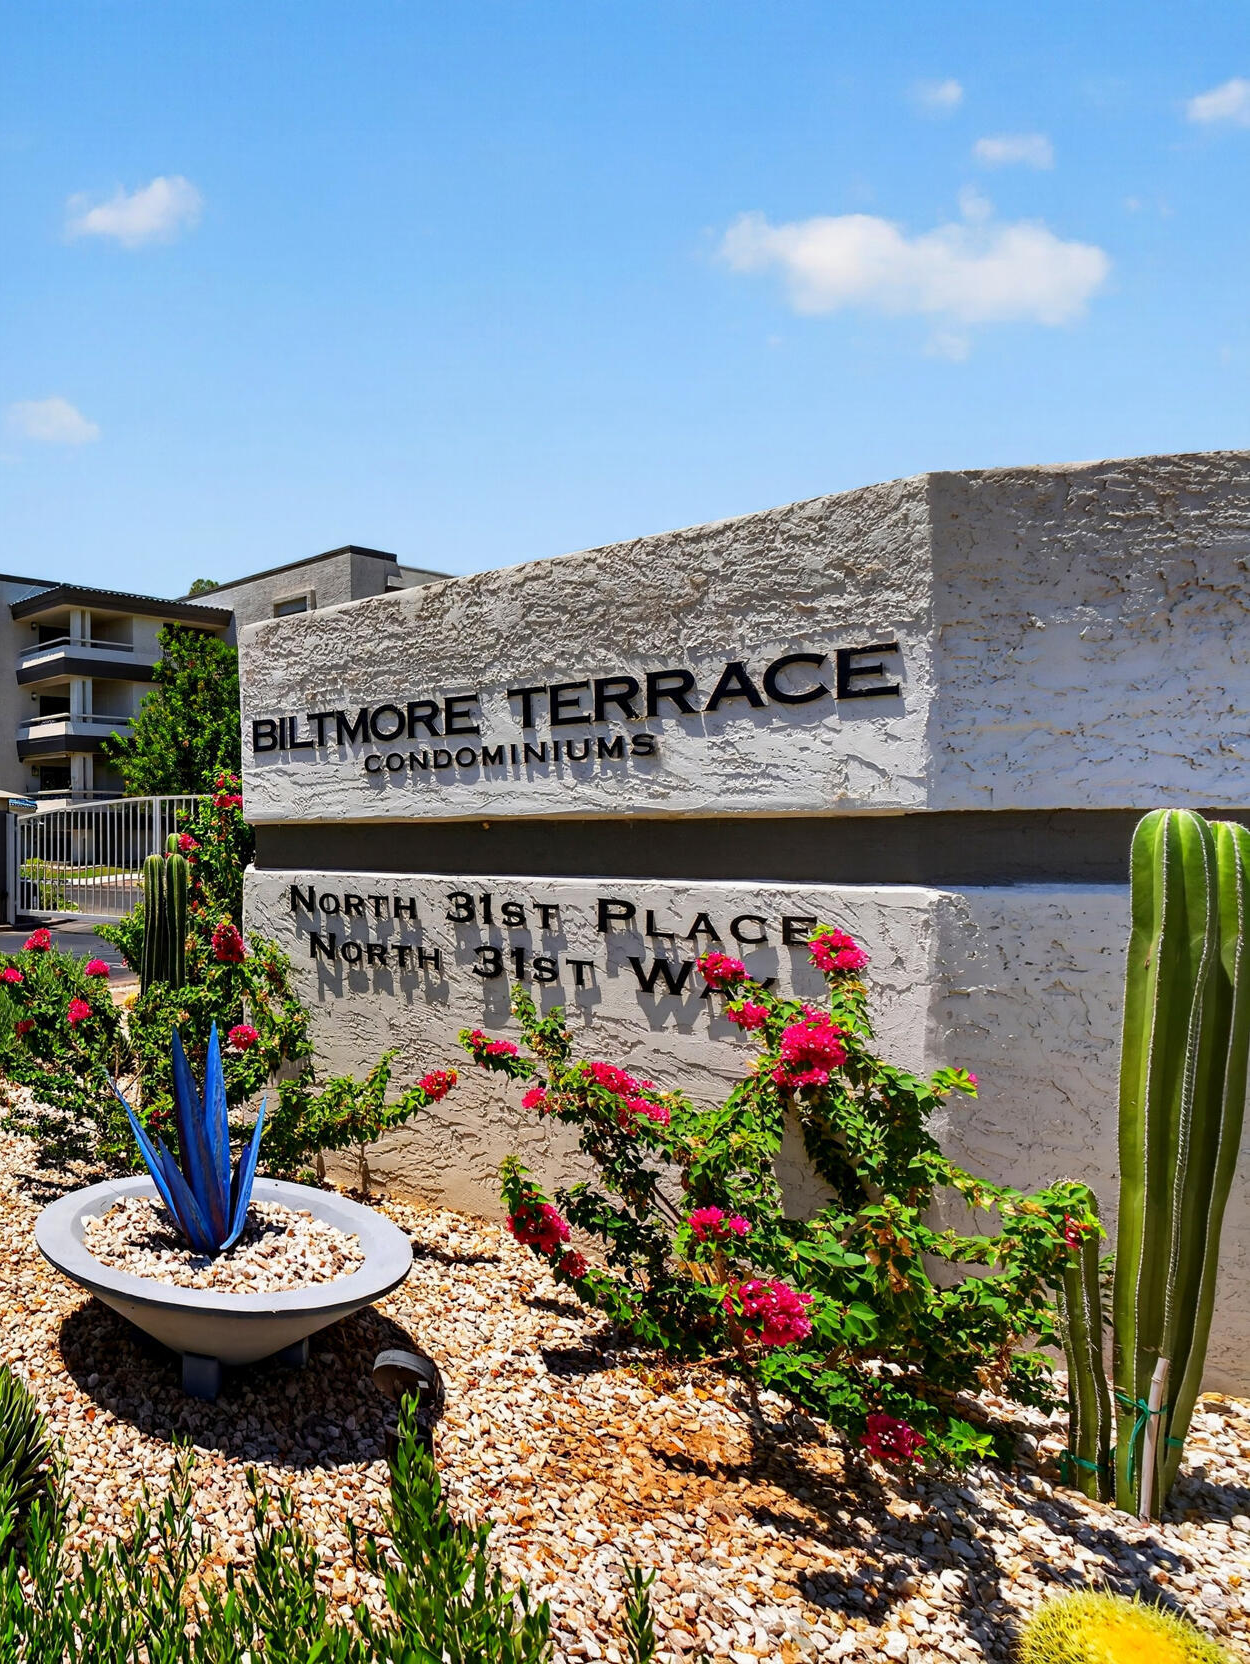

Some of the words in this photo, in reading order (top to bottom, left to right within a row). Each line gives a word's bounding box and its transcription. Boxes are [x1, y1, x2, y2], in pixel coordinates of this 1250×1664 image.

[252, 692, 480, 752] BILTMORE
[506, 641, 901, 729] TERRACE
[364, 733, 656, 773] CONDOMINIUMS
[290, 884, 418, 920] NORTH
[446, 891, 559, 929] 31ST
[596, 897, 818, 946] PLACE
[309, 931, 441, 971] NORTH
[472, 945, 594, 986] 31ST
